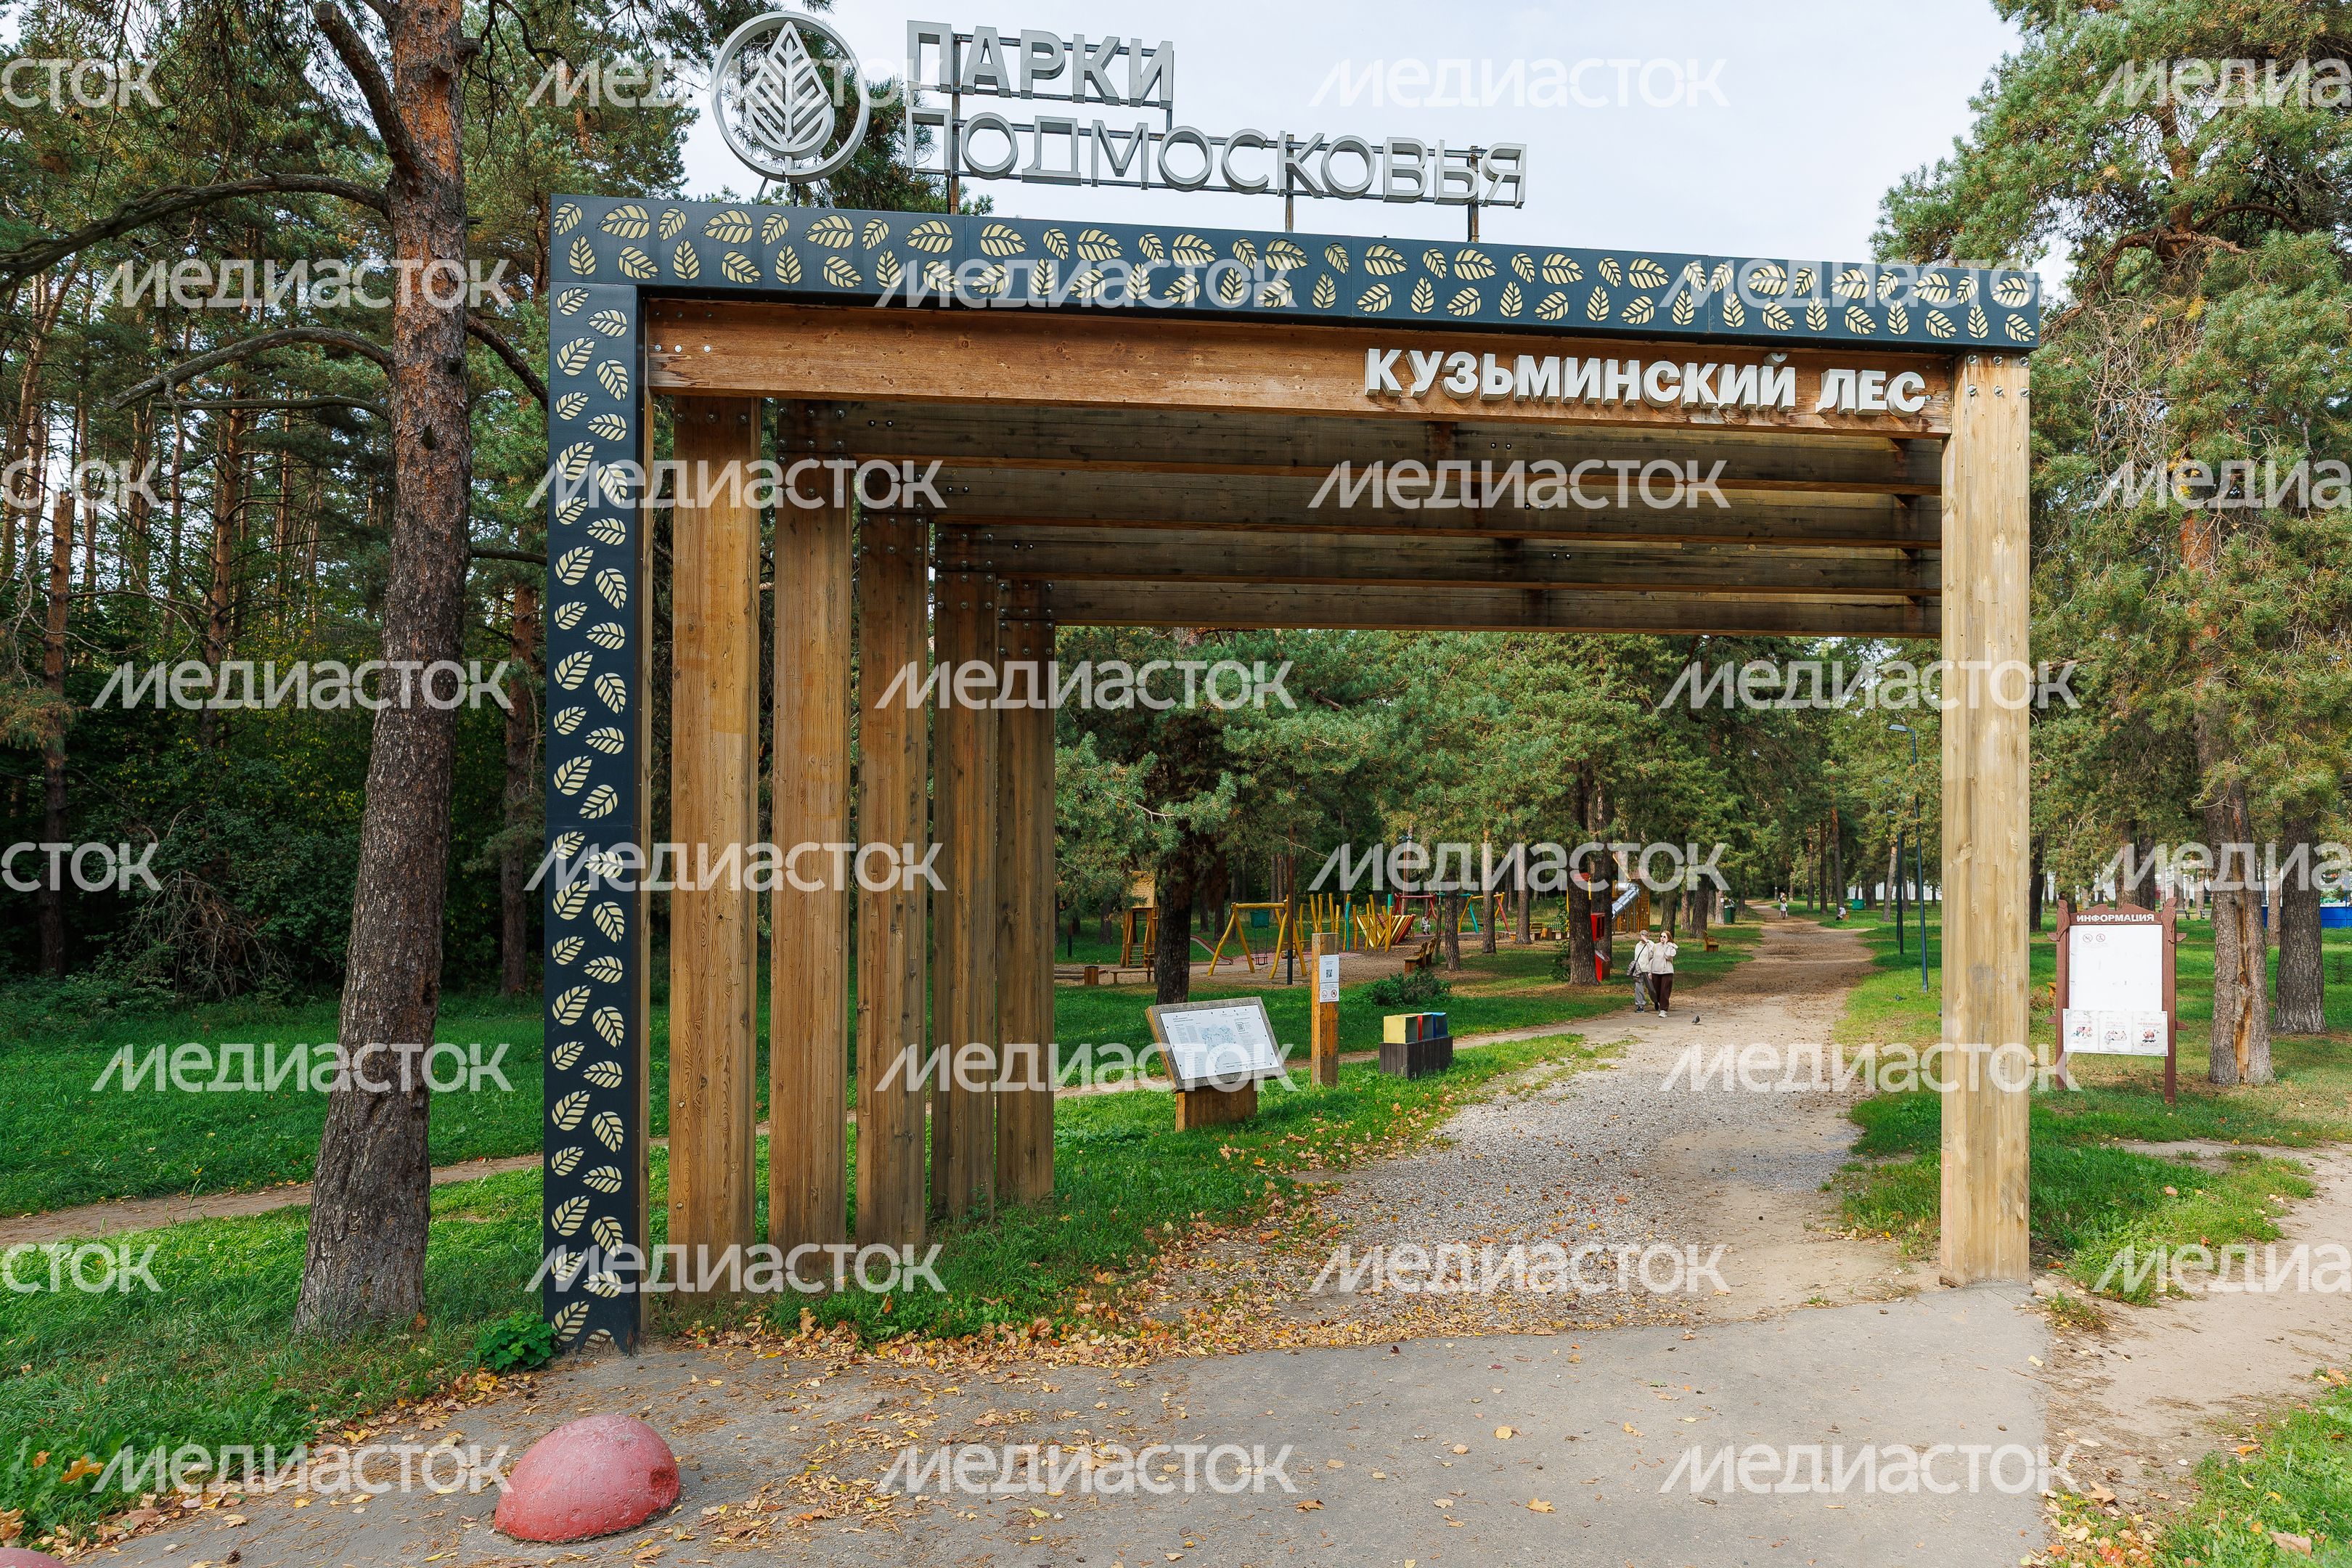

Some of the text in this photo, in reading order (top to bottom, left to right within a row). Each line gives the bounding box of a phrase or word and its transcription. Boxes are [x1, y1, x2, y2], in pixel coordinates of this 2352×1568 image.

[907, 20, 1174, 109] ПАРКИ
[905, 107, 1528, 209] ПОДМОСКОВЬЯ
[1364, 348, 1926, 417] КУЗЬМИНСКИЙ ЛЕС
[2076, 913, 2155, 923] ИНФОРМАЦИЯ
